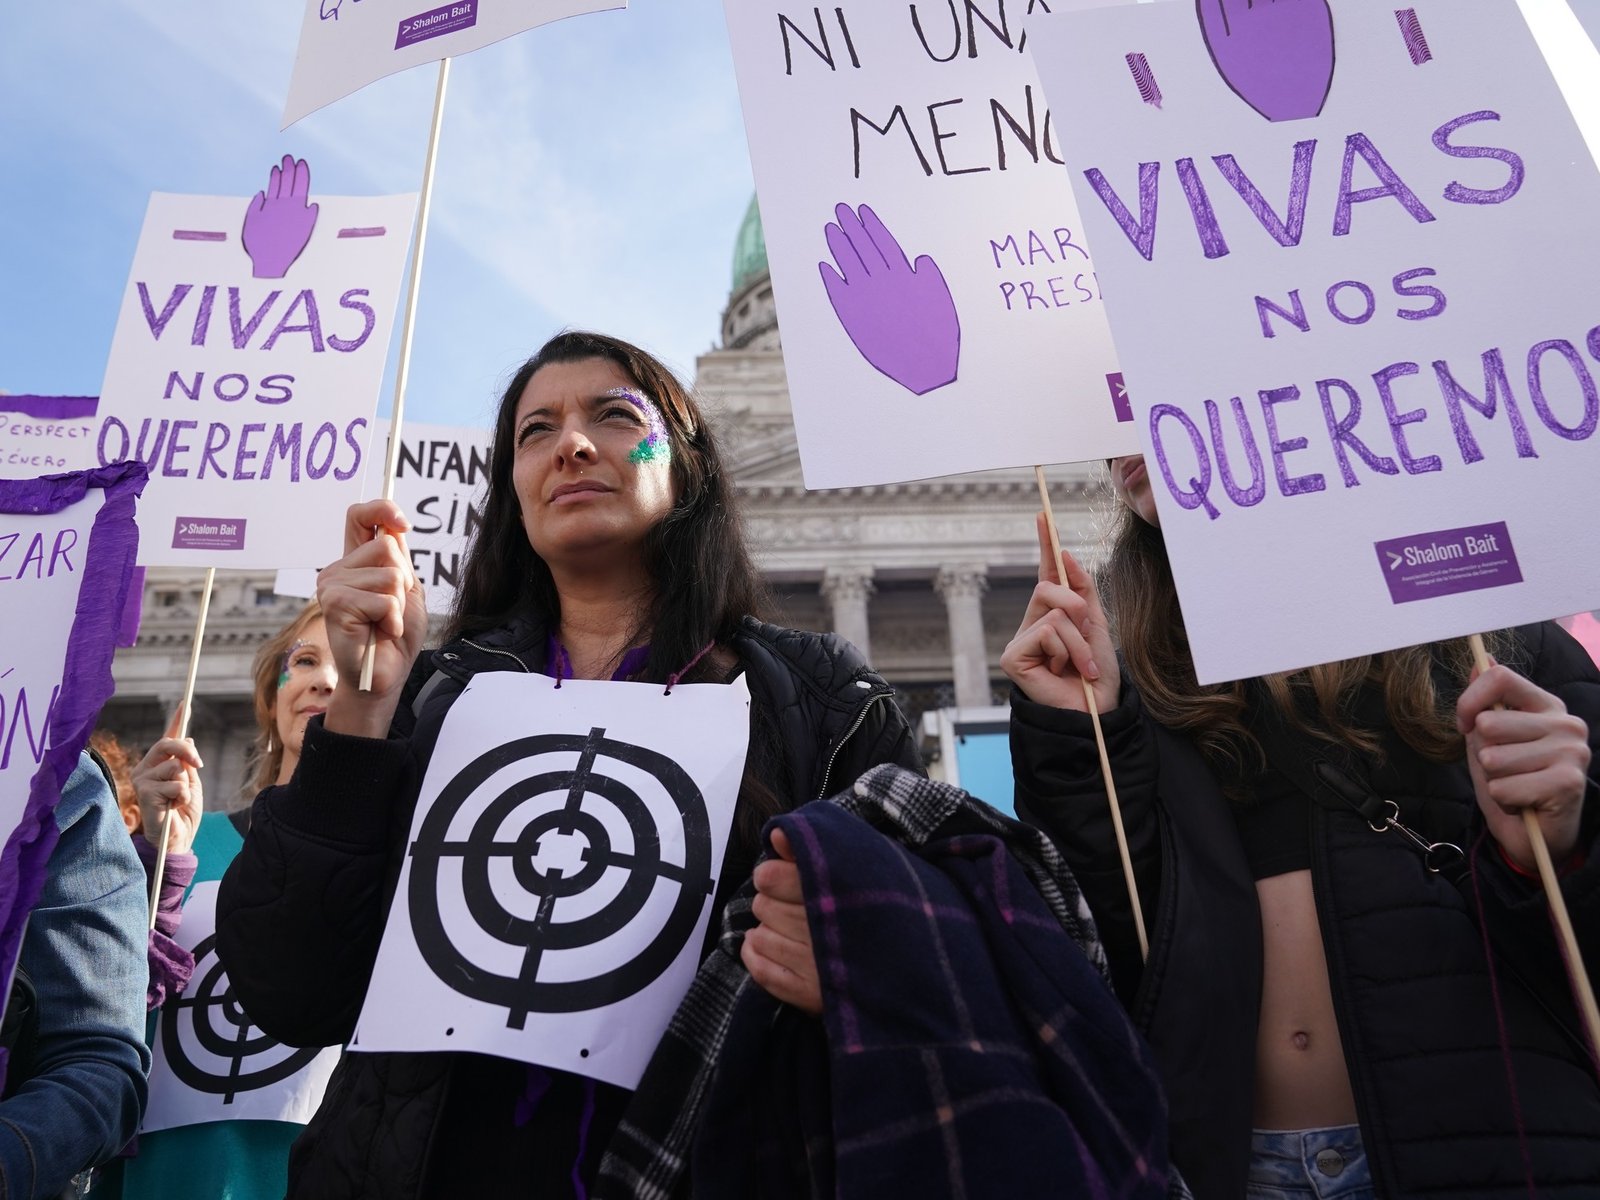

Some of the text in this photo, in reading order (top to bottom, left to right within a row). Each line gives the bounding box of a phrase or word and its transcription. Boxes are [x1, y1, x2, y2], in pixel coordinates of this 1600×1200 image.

[412, 12, 448, 30] Shalom
[451, 3, 472, 17] Bait
[777, 7, 861, 75] NI
[1083, 110, 1525, 262] VIVAS
[990, 228, 1089, 268] MAR
[136, 281, 376, 353] VIVAS
[1255, 267, 1447, 338] NOS
[163, 370, 296, 404] NOS
[1149, 324, 1600, 520] QUEREMO
[0, 448, 66, 467] ÉNERO
[97, 415, 367, 482] QUEREMOS
[384, 436, 492, 485] NFAN
[0, 529, 78, 580] ZAR
[188, 523, 237, 536] Shalom Bait
[1403, 533, 1500, 566] Shalom Bait
